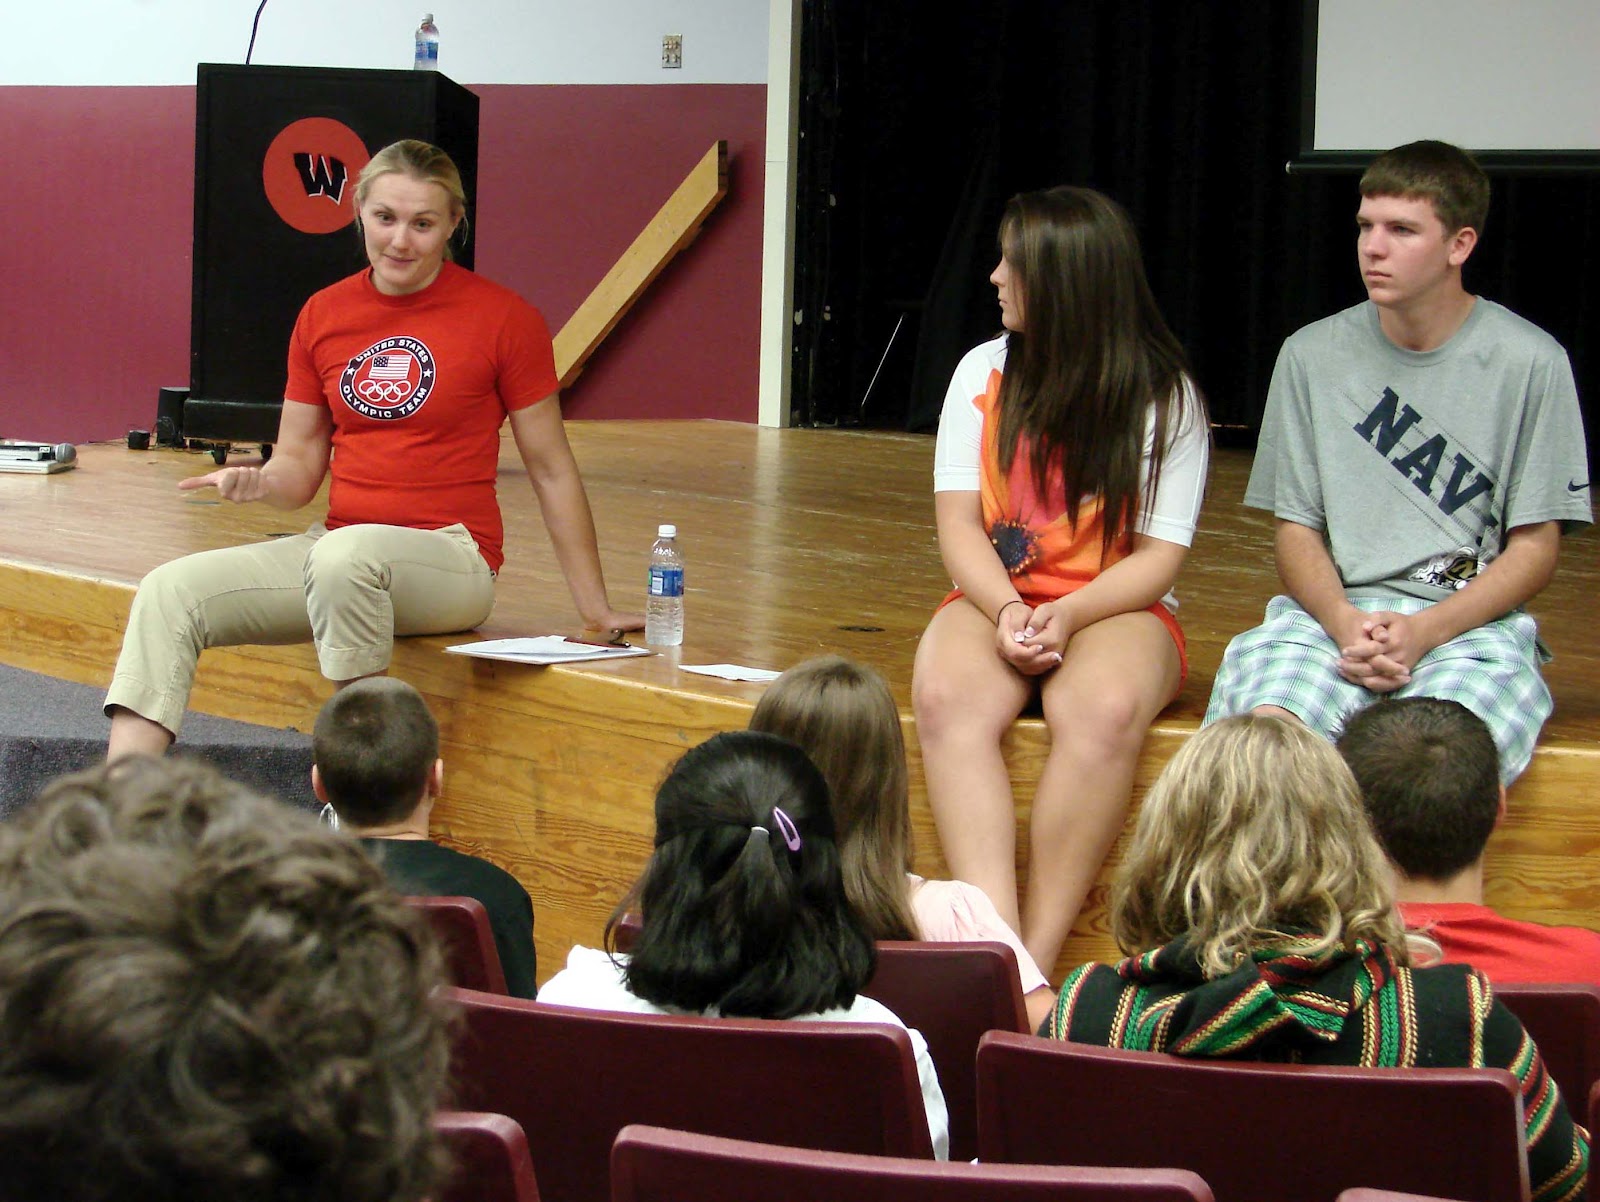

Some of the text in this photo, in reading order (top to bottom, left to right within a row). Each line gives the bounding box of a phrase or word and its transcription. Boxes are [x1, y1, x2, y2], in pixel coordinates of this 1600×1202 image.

[293, 152, 348, 206] W
[355, 339, 429, 363] UNITED STATES
[343, 385, 427, 418] OLYMPIC TEAM
